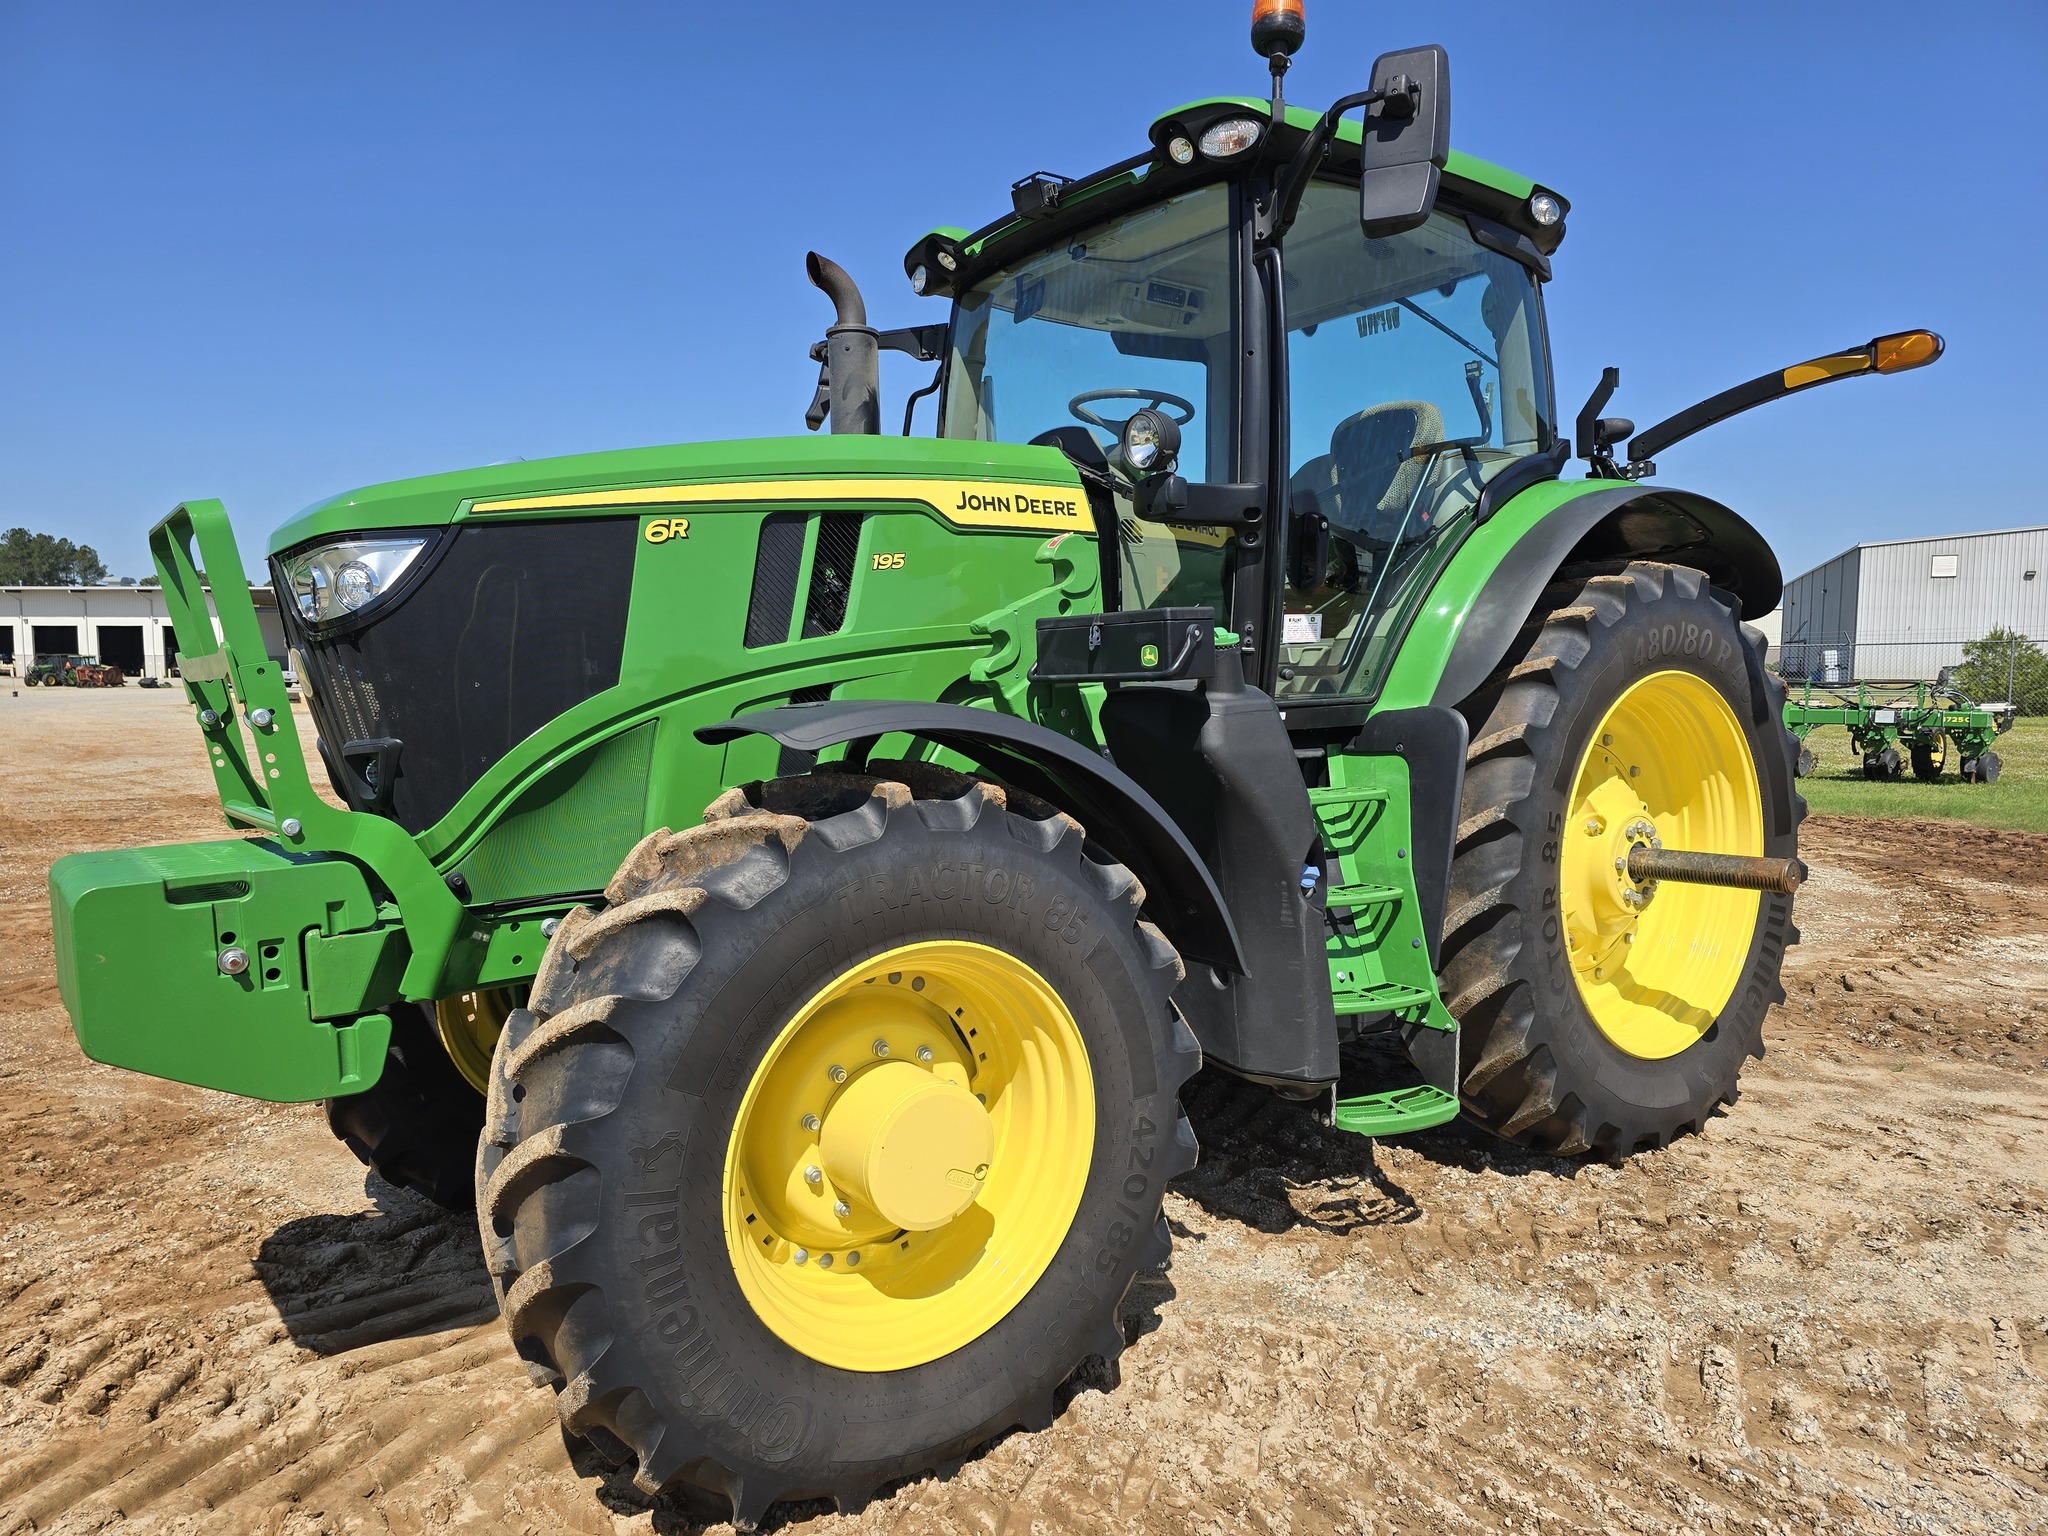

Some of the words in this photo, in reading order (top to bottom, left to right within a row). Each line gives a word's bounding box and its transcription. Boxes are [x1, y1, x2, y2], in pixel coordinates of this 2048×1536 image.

[956, 491, 1011, 512] JOHN
[1015, 495, 1077, 516] DEERE
[644, 518, 690, 545] 6R
[872, 553, 906, 570] 195
[1633, 621, 1713, 668] 480/80
[1712, 636, 1732, 674] R
[1542, 810, 1562, 865] 85
[835, 860, 1035, 924] TRACTOR
[1043, 893, 1089, 945] 85
[1095, 1114, 1158, 1278] 420/85
[623, 1183, 817, 1464] Continental
[1067, 1283, 1101, 1320] R
[1024, 1319, 1072, 1379] 30
